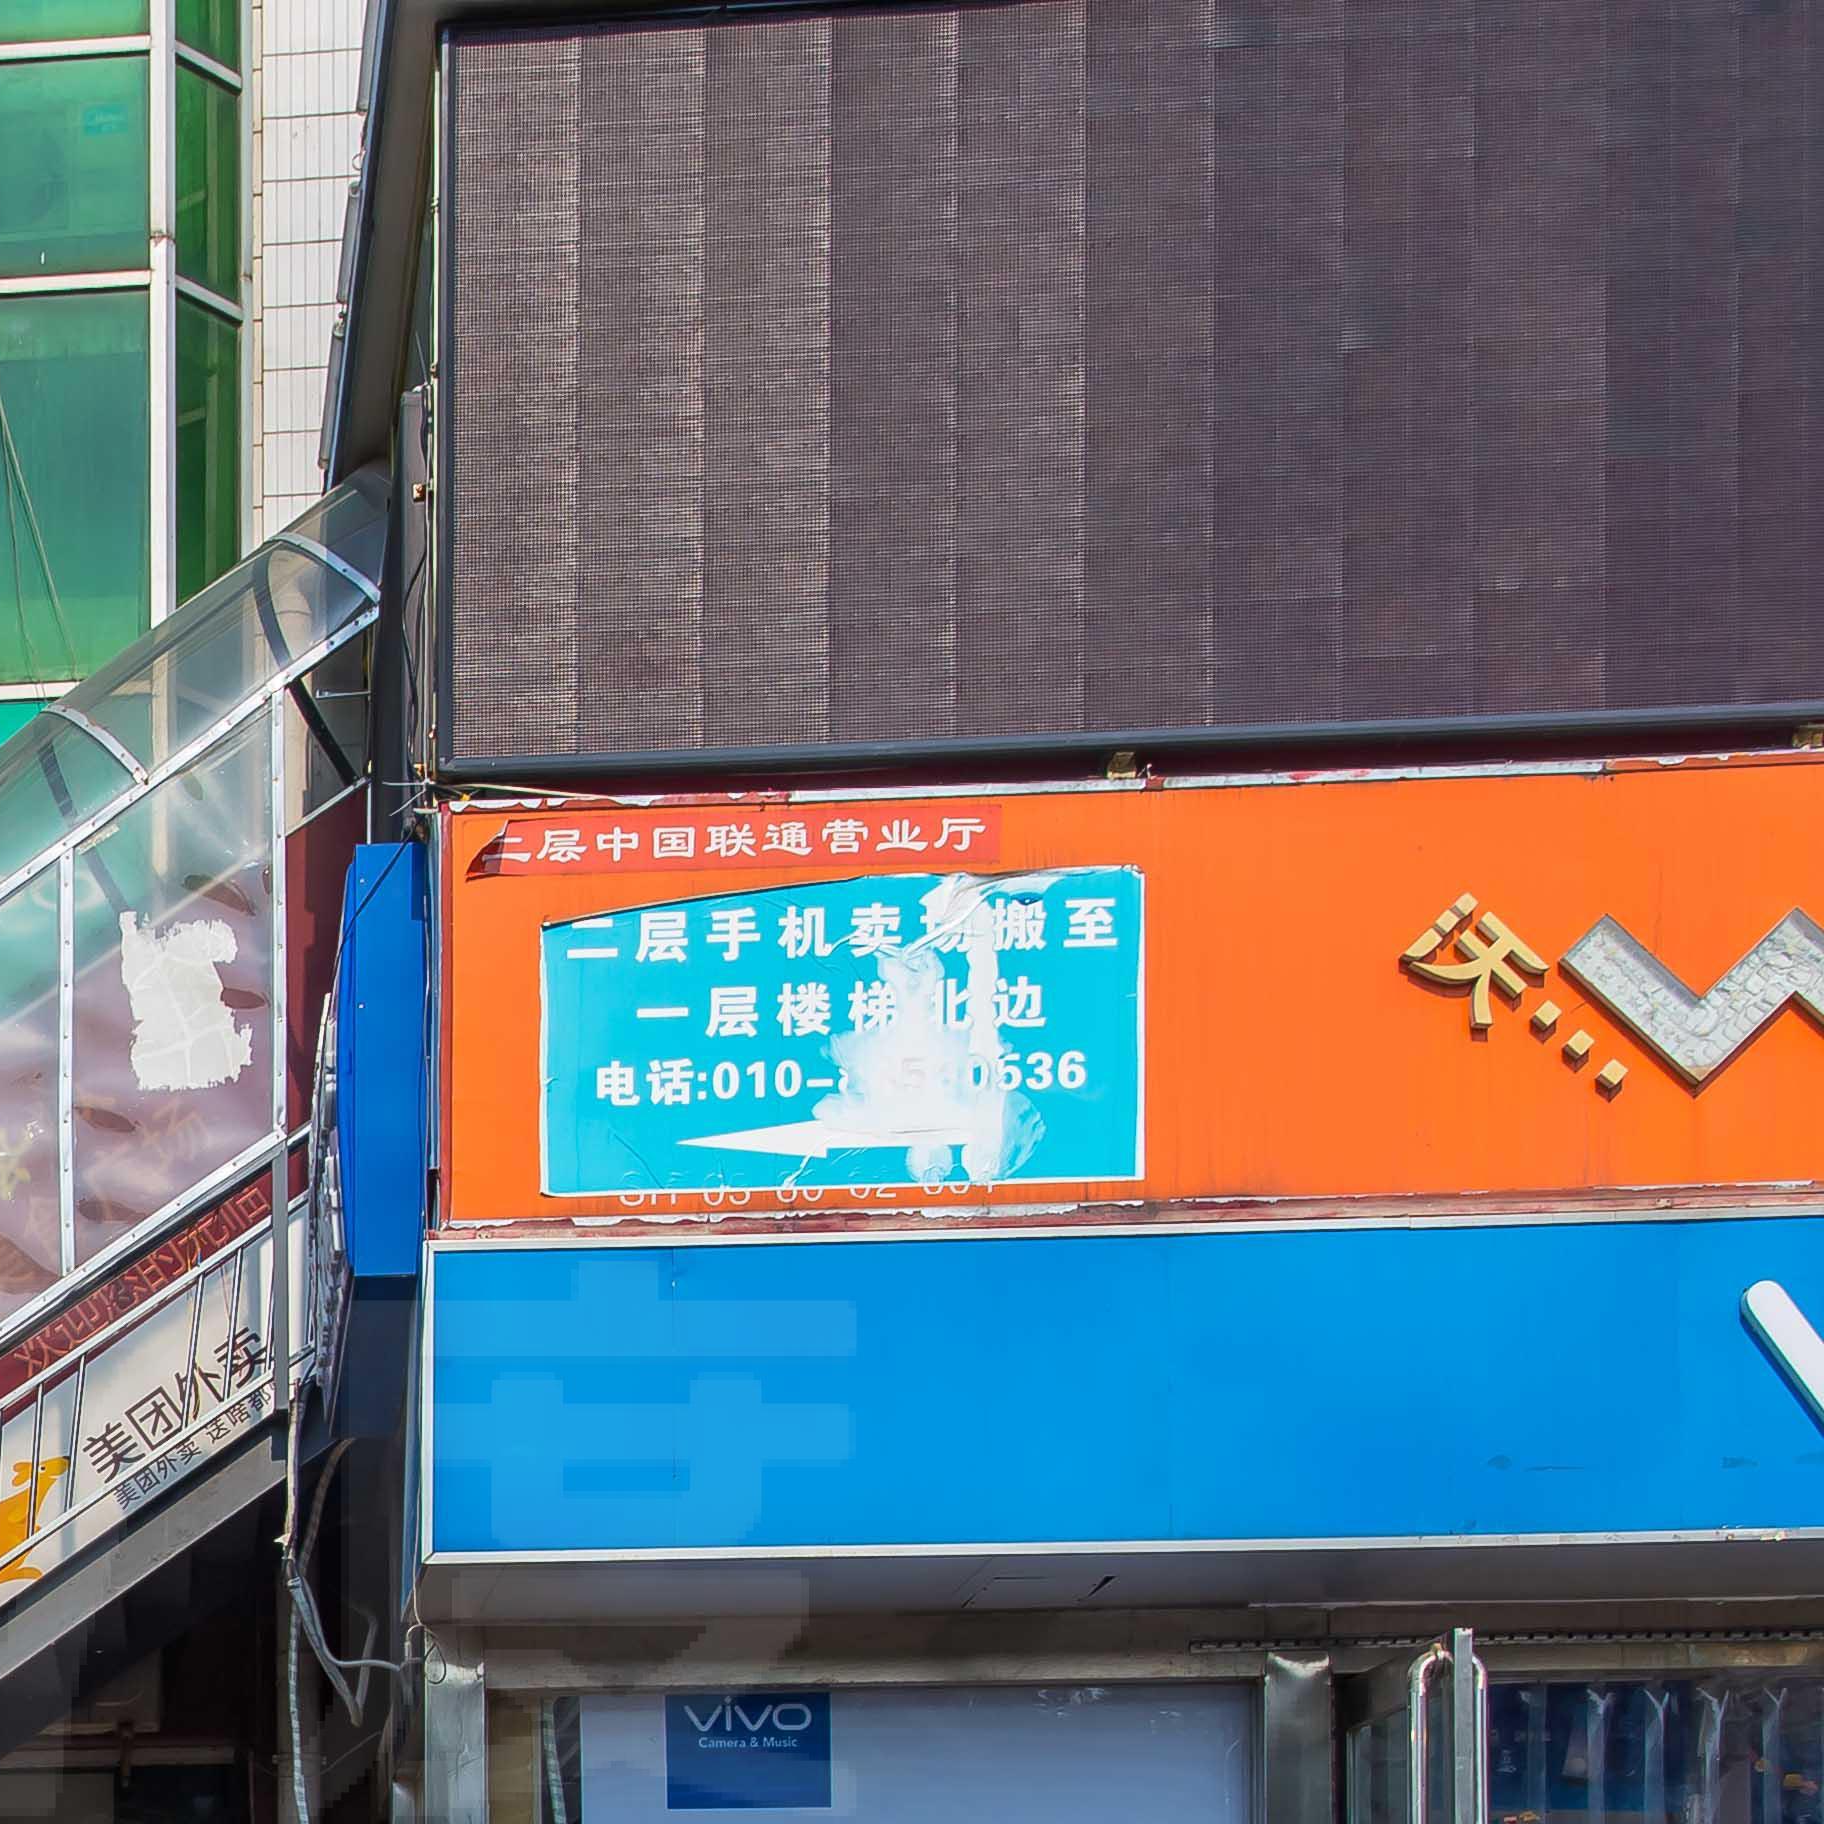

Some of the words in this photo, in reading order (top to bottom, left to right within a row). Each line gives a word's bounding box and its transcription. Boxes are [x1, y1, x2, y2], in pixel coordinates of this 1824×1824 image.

[498, 818, 988, 864] 二层中国联通营业厅
[82, 1326, 270, 1484] 美团外卖
[685, 1695, 813, 1734] vivo
[698, 1737, 748, 1749] Camera
[763, 1737, 798, 1749] Music
